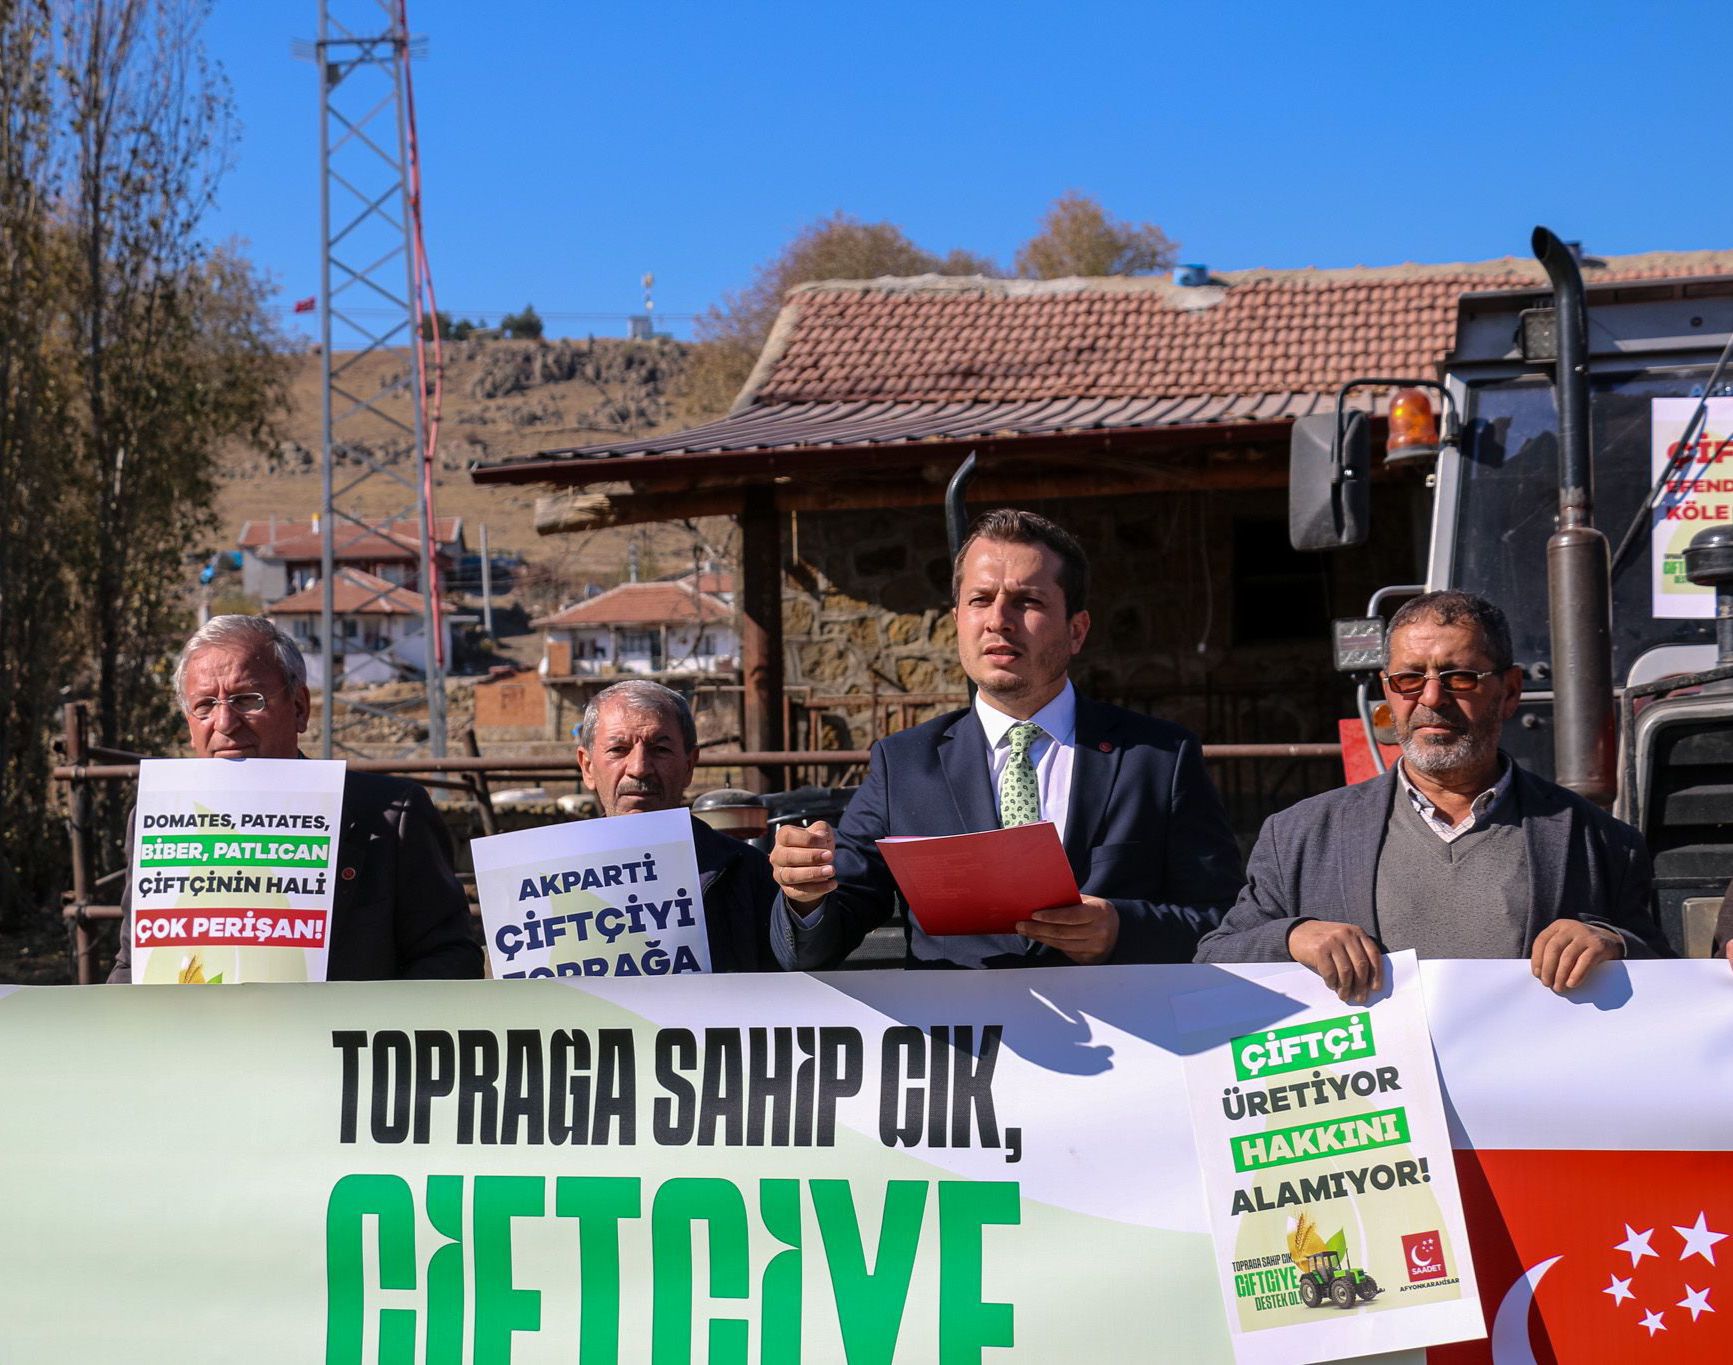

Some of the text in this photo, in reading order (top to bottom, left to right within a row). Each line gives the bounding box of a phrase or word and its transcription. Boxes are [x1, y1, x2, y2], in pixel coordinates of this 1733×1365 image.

[143, 814, 331, 832] DOMATES, PATATES,
[141, 838, 329, 861] BİBER, PATLICAN
[138, 870, 326, 898] ÇİFTÇİNİN HALİ
[518, 853, 658, 901] AKPARTİ
[136, 911, 324, 943] ÇOK PERİŞAN!
[495, 888, 696, 961] ÇİFTÇİYİ
[1241, 1015, 1367, 1075] ÇİFTÇİ
[1222, 1065, 1403, 1121] ÜRETİYOR
[1241, 1114, 1401, 1166] HAKKINI
[1231, 1157, 1431, 1216] ALAMIYOR!
[1400, 1278, 1460, 1292] AFYONKARAHİSAR
[1411, 1264, 1442, 1275] SAADET
[1255, 1293, 1288, 1311] DESTEK
